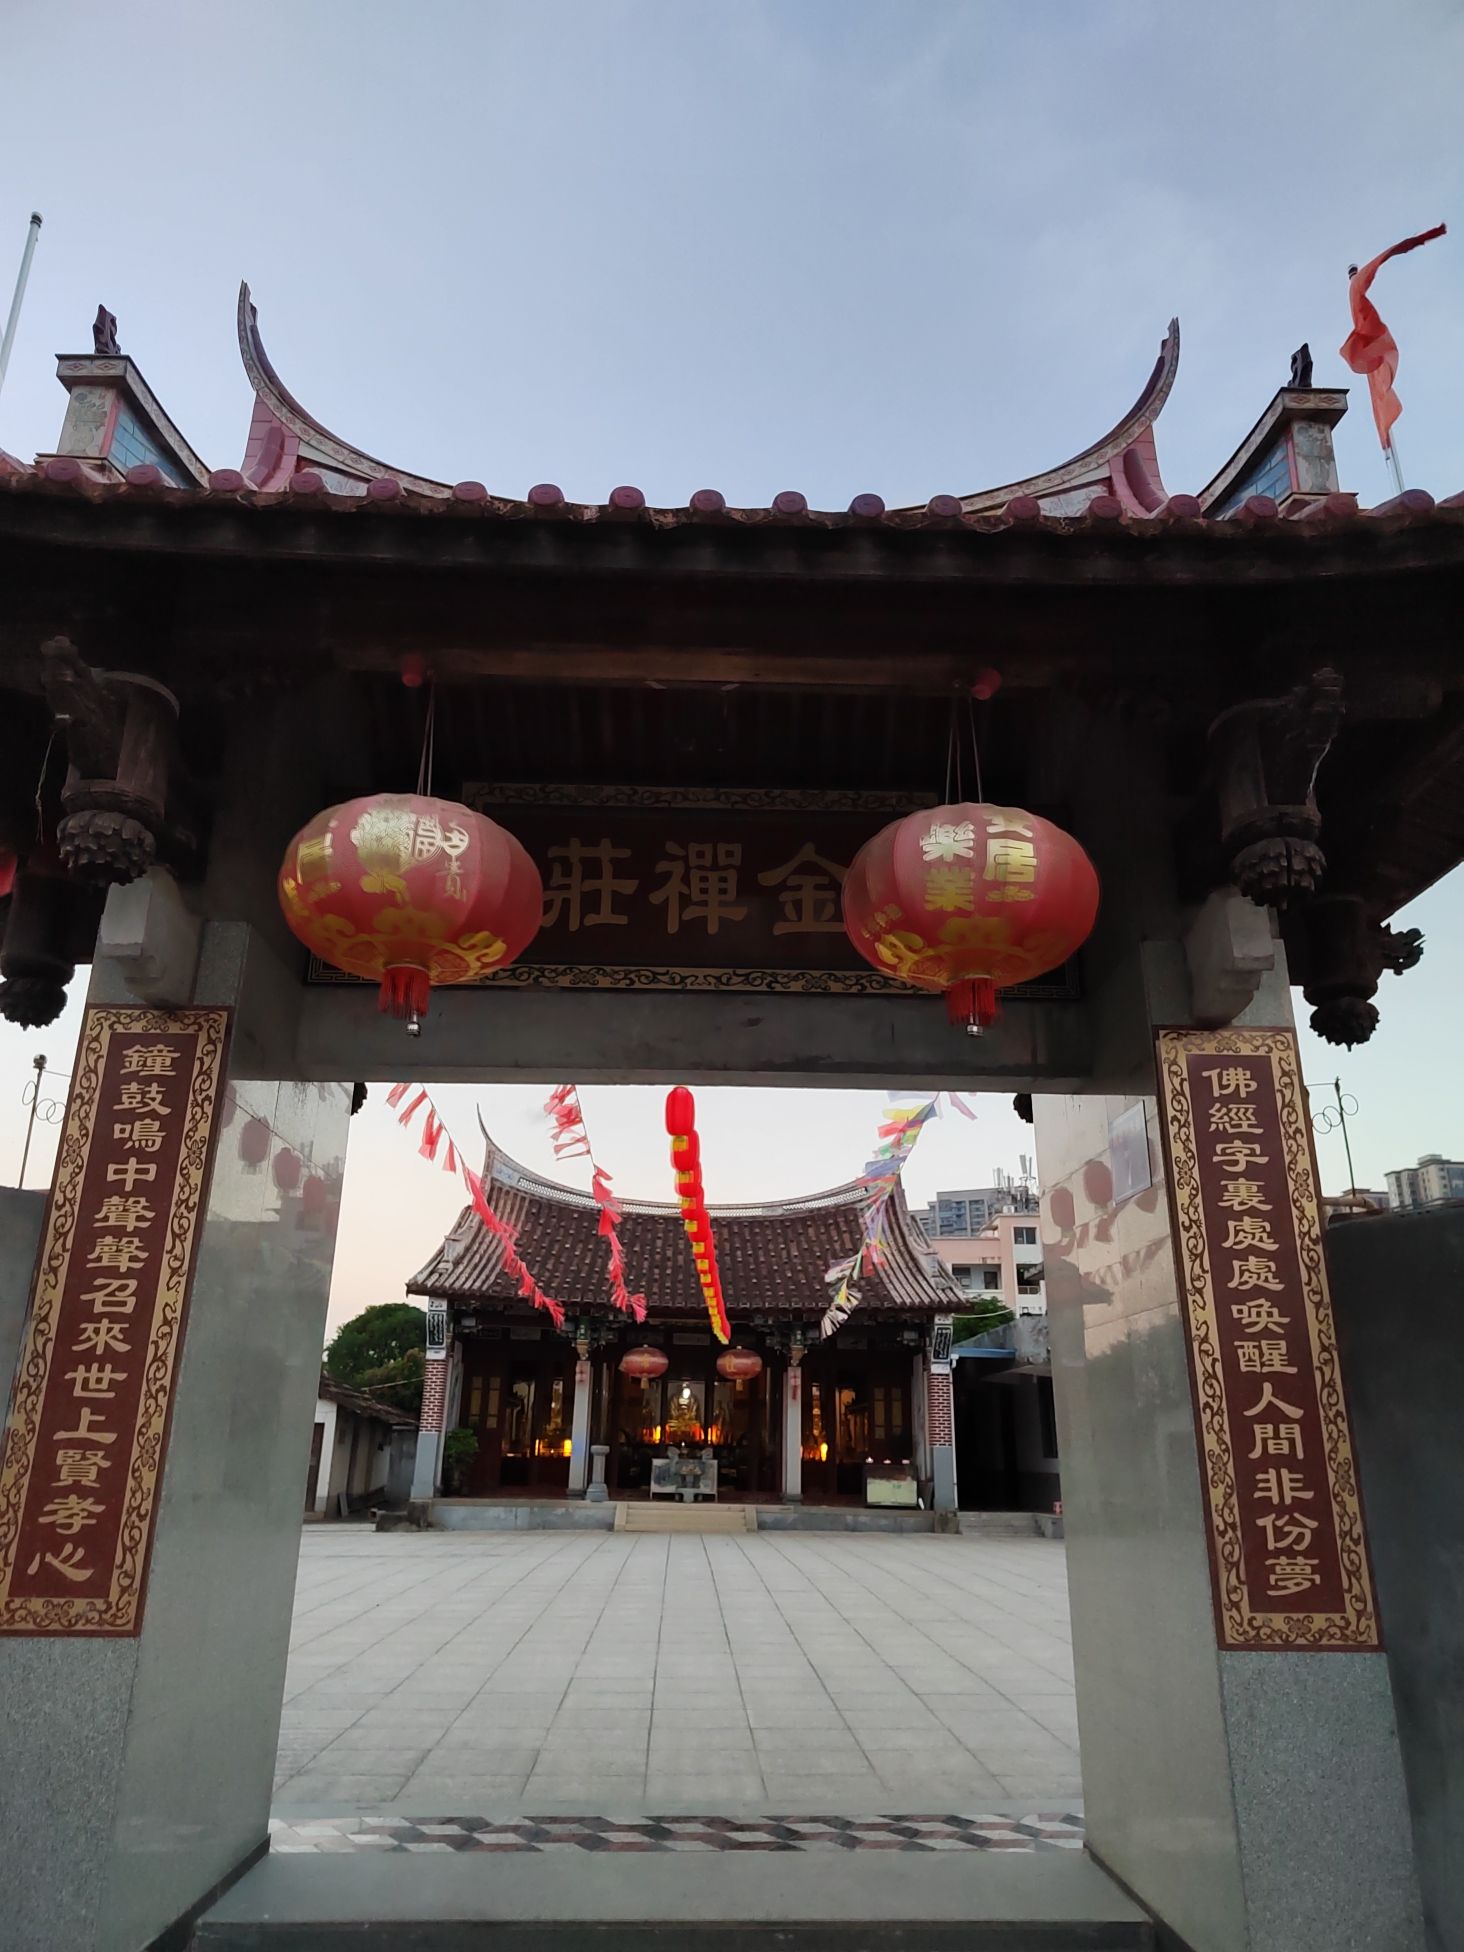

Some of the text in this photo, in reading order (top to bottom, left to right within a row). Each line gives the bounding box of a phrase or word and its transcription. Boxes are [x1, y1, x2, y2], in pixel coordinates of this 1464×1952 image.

[27, 1043, 181, 1582] 鐘鼓鳴中聲聲召來世上賢孝心
